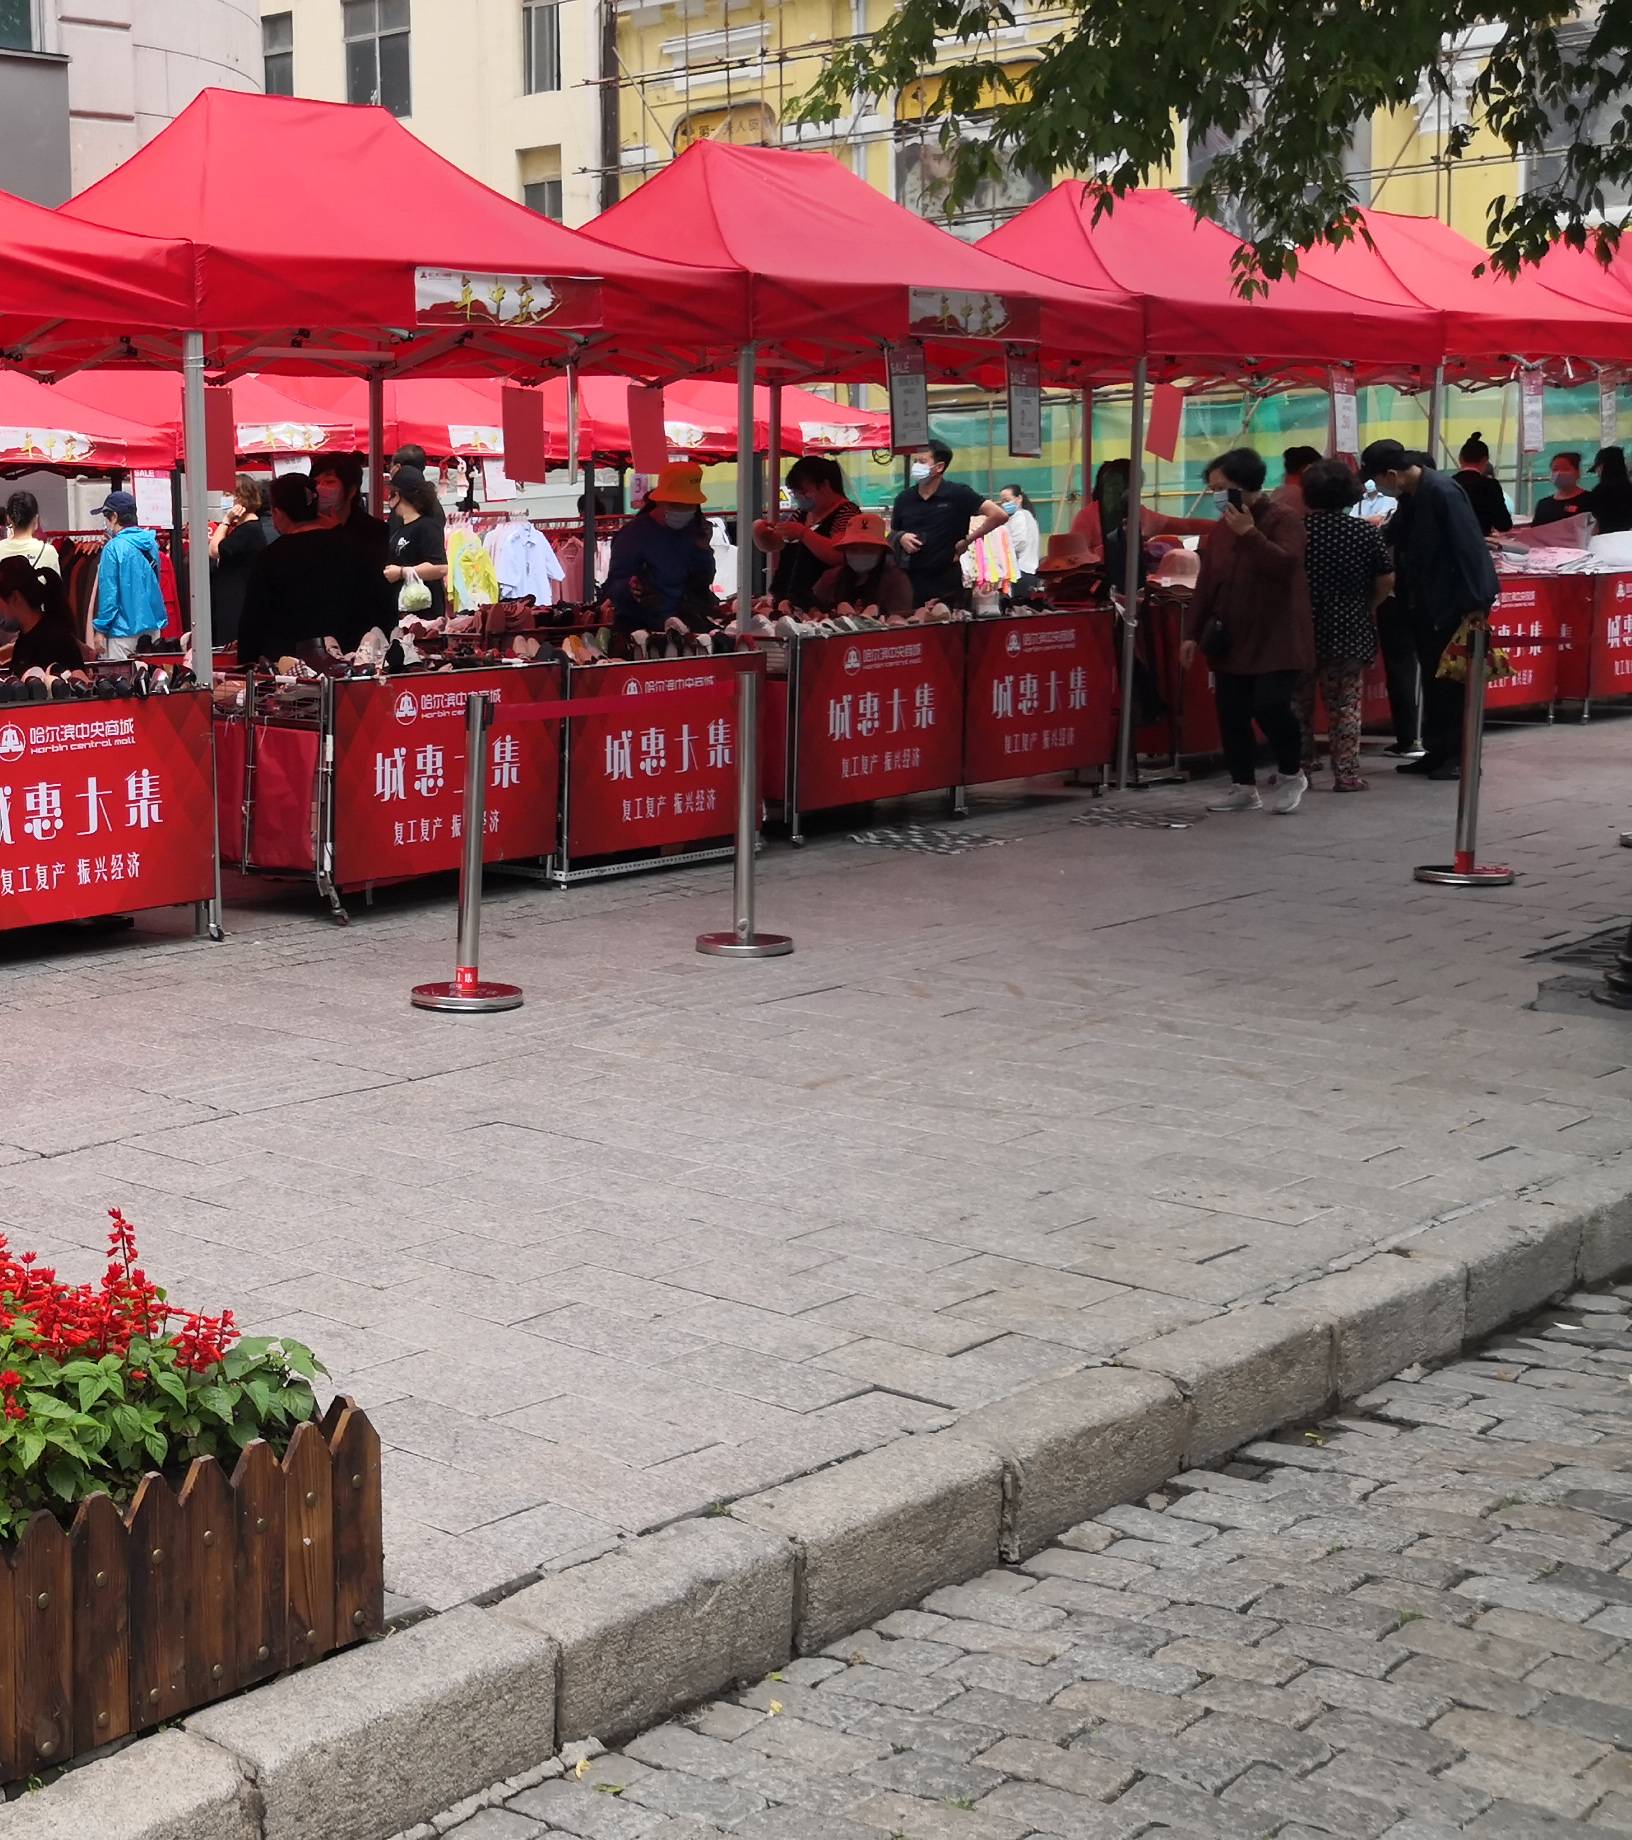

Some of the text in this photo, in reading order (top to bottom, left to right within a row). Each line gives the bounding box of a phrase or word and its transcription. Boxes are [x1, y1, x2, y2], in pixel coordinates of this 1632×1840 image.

[421, 688, 501, 711] 哈尔滨中城
[828, 682, 936, 741] 城惠大集
[992, 666, 1088, 719] 城惠大集
[29, 717, 134, 745] 哈尔滨中央商城
[30, 736, 136, 754] Harbin central mall
[605, 719, 731, 780] 城惠大集
[374, 734, 520, 802] 城惠集
[622, 788, 716, 822] 复工复产 振兴经济
[393, 809, 500, 846] 复工复产 振济
[1, 852, 139, 896] 复工复产 振兴经济
